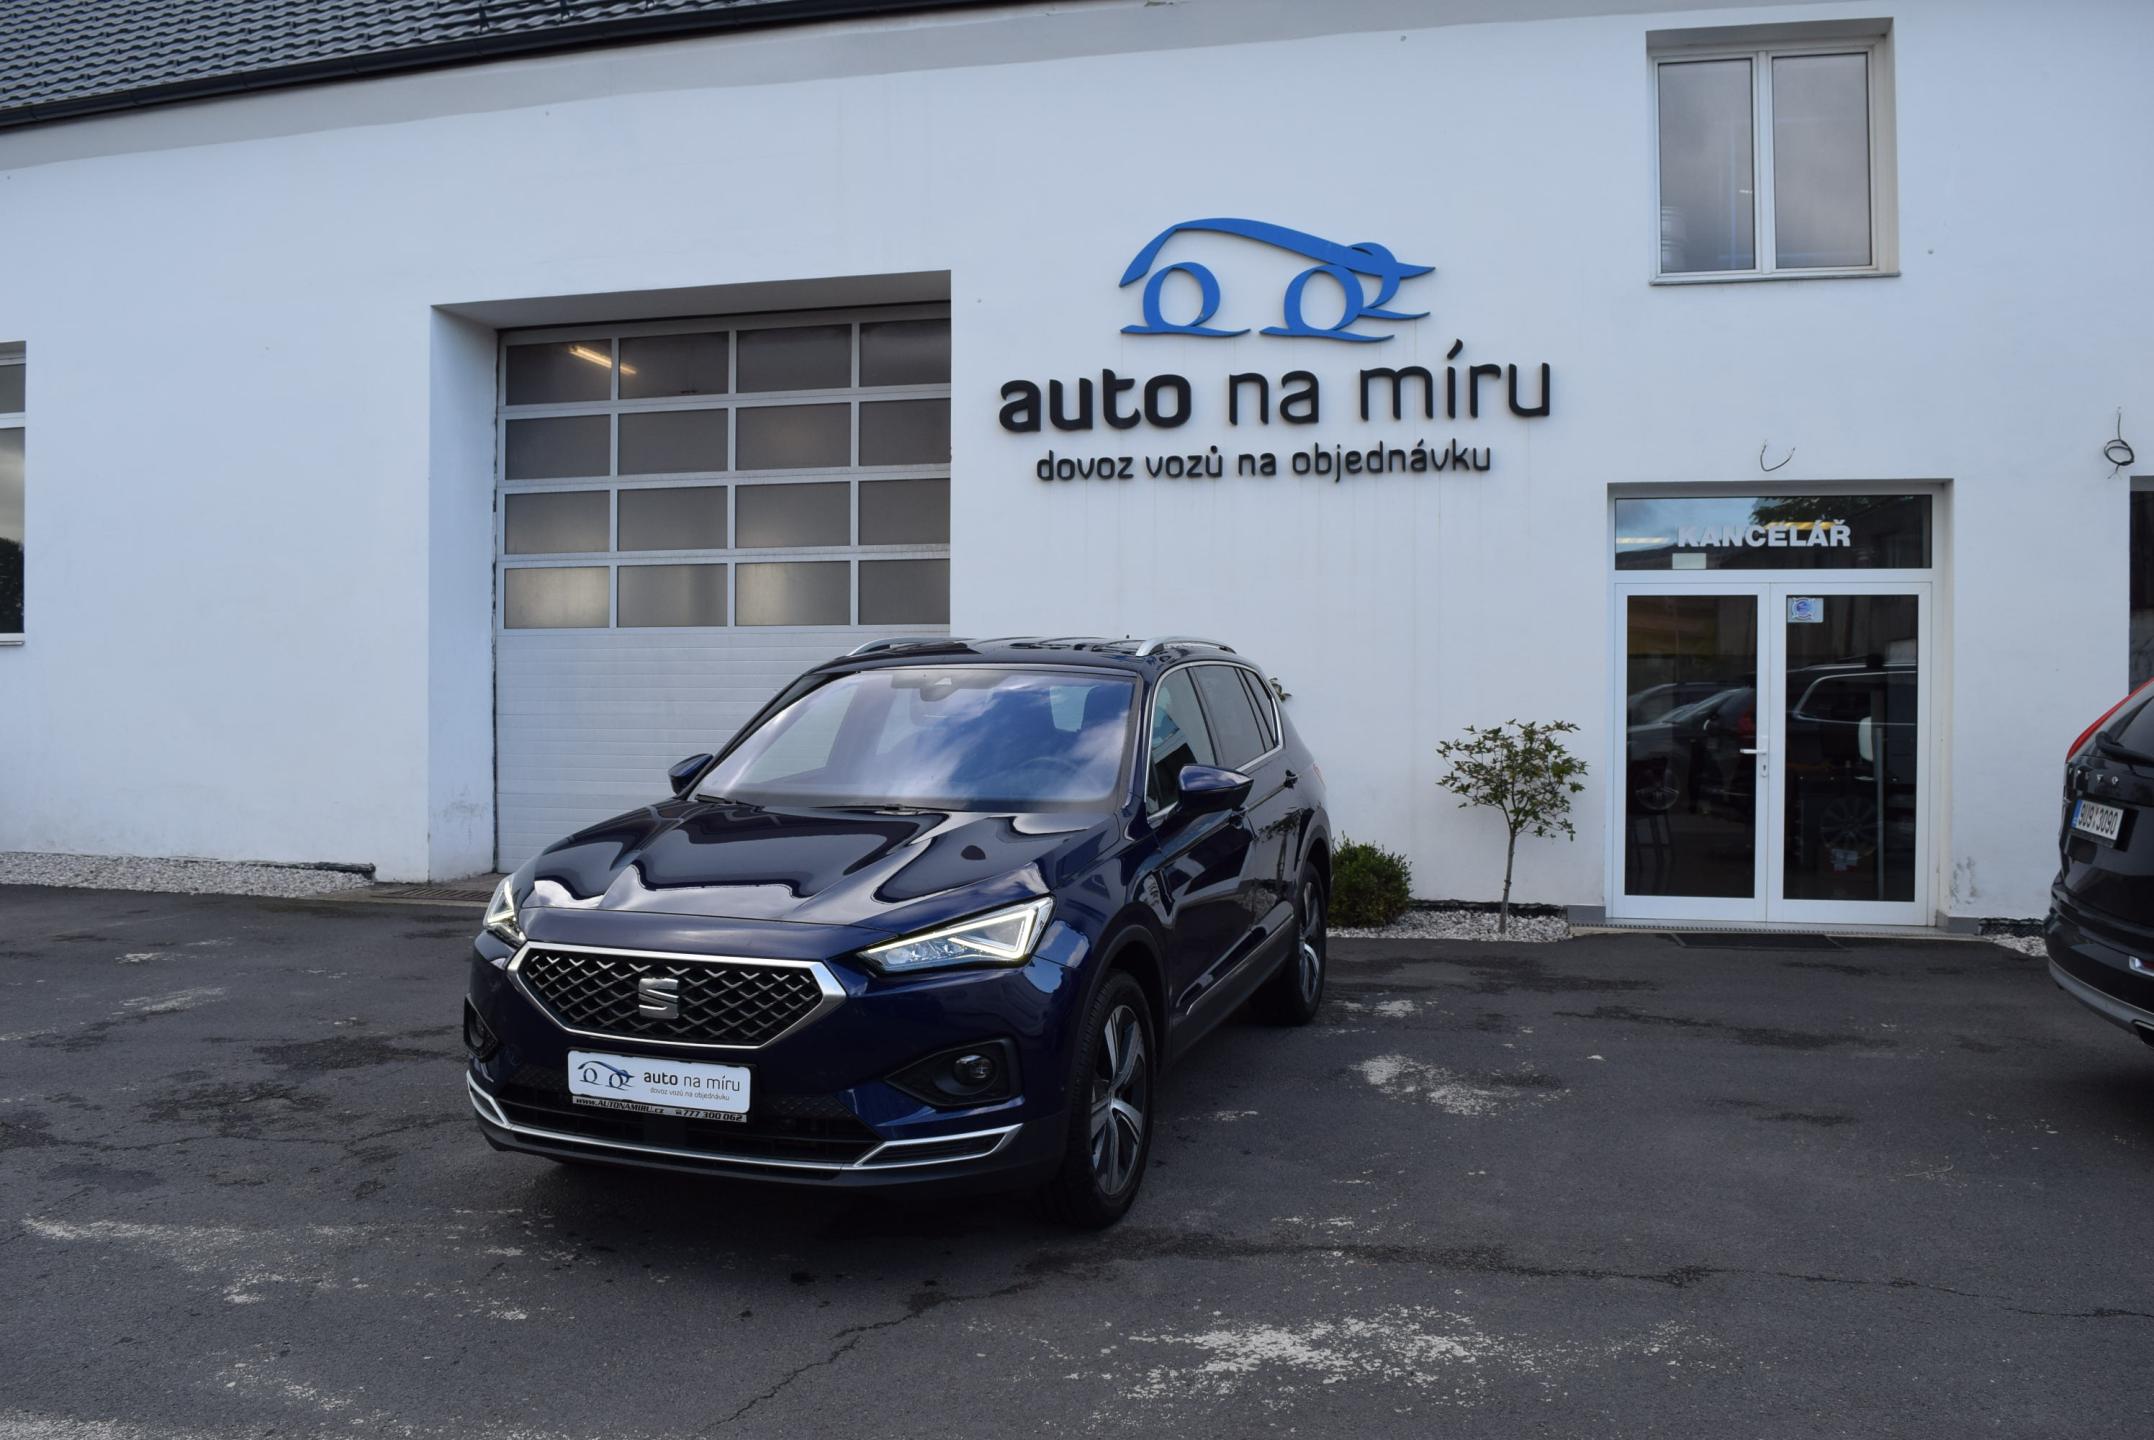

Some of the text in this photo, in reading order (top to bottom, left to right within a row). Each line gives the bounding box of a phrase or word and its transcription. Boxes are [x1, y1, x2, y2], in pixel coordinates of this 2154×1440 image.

[999, 338, 1551, 433] auto na míru
[1036, 438, 1491, 483] dovoz vozů na objednávku
[1677, 519, 1851, 548] KANCELÁŘ
[643, 1071, 741, 1092] auto na míru
